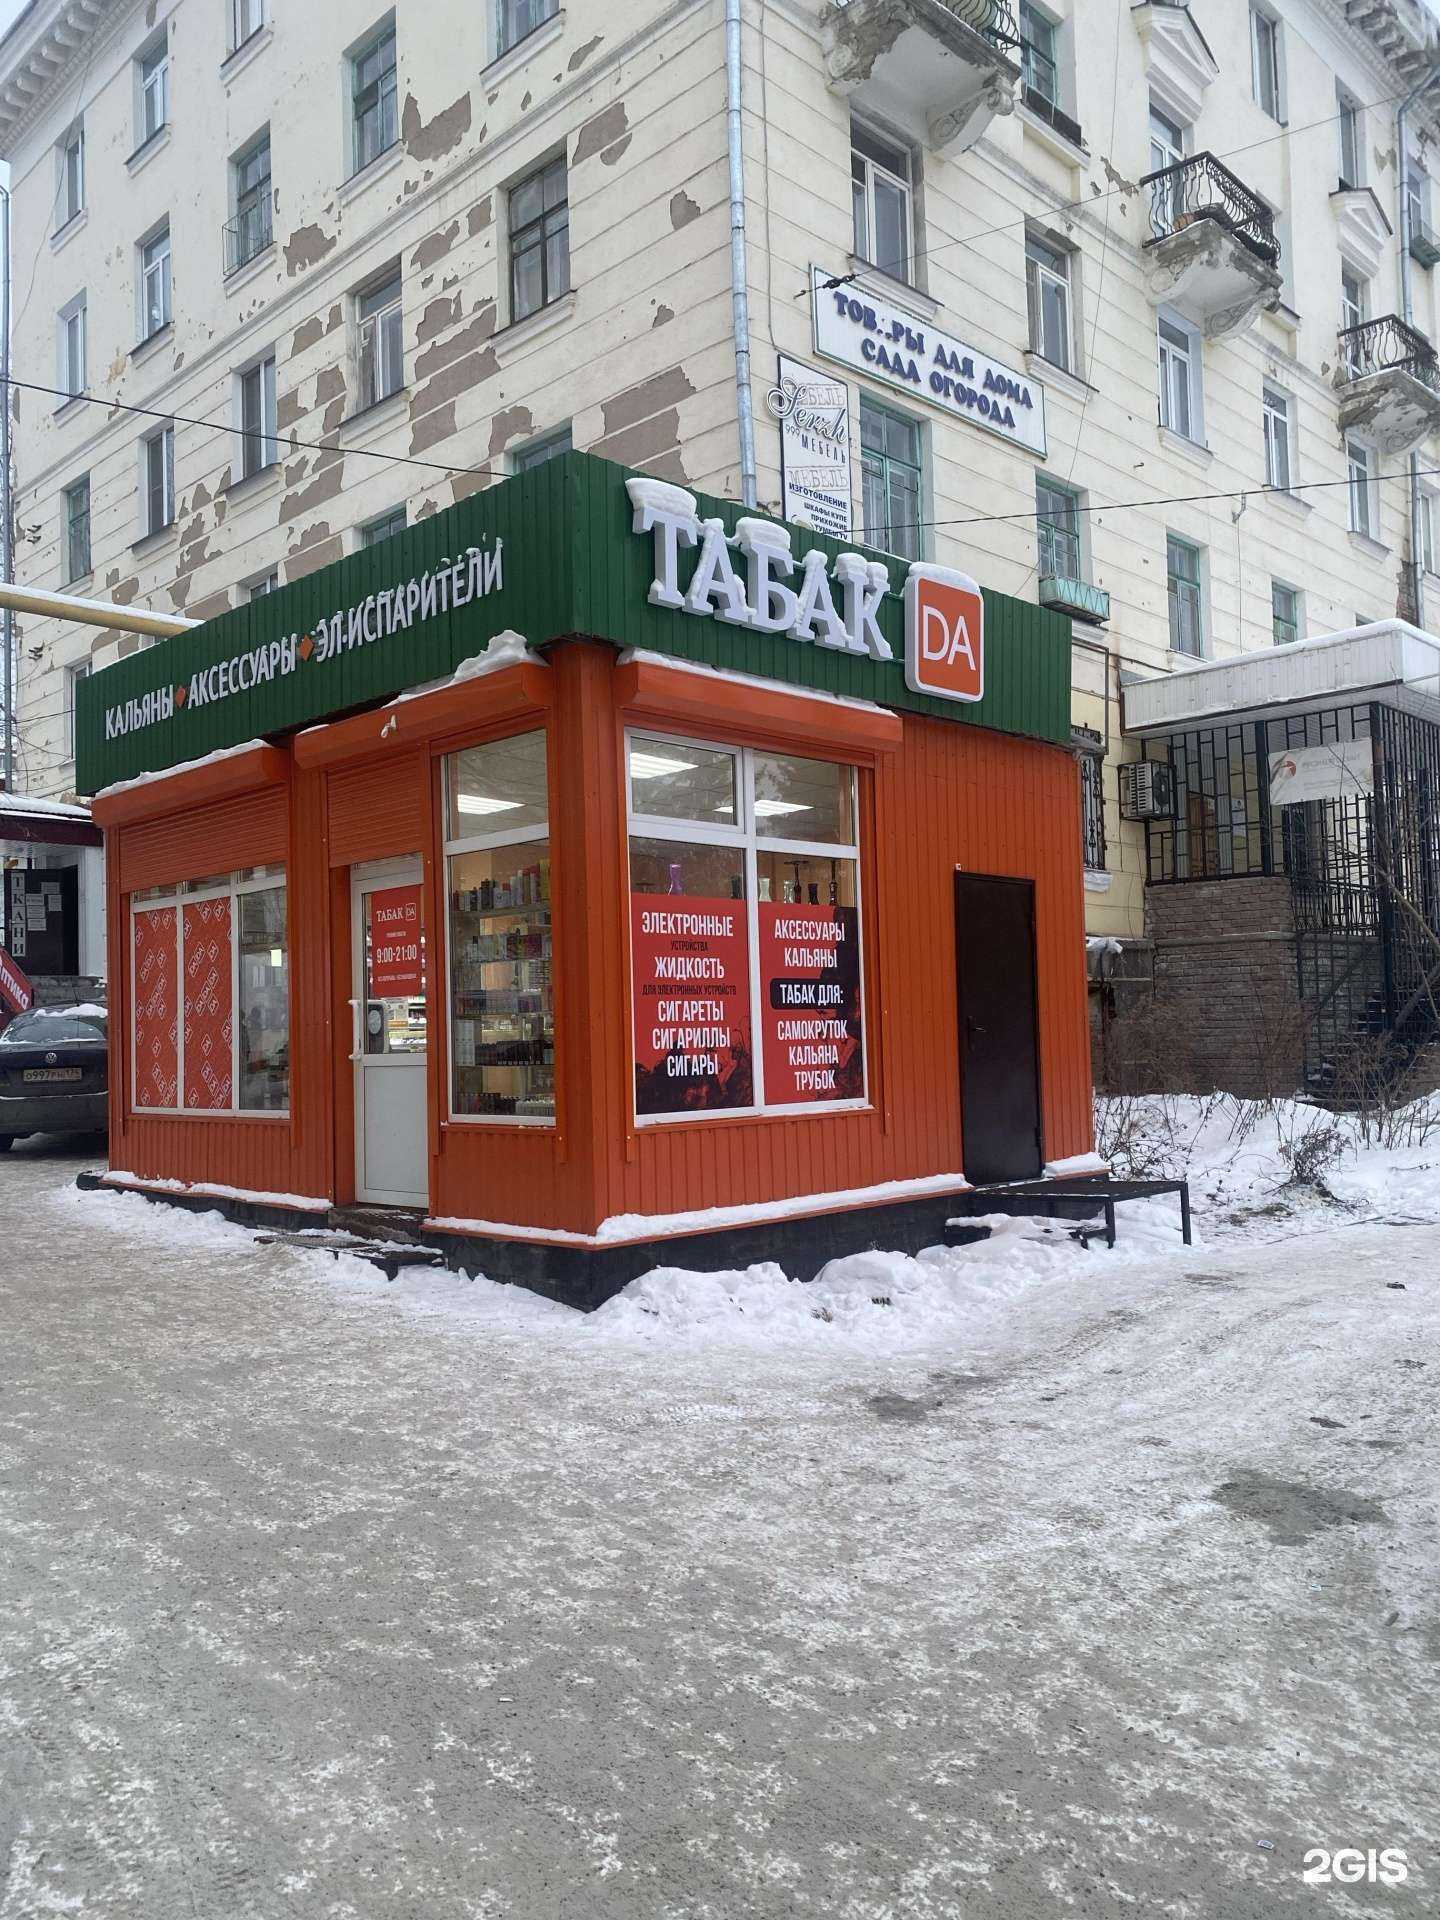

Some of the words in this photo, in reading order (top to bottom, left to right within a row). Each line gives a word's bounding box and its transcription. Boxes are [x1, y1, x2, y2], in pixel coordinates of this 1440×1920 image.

[833, 291, 926, 355] ТОВРЫ
[933, 343, 975, 379] ДЛЯ
[983, 368, 1034, 410] ДОМА
[861, 338, 922, 383] САДА
[929, 371, 1016, 429] ОГОРОДА
[801, 433, 846, 464] МЕБЕЛЬ
[788, 482, 848, 510] ИЗГОТОВЛЕНИЕ
[632, 505, 894, 662] ТАБАК
[923, 604, 977, 671] DA
[105, 685, 174, 740] КАЛЬЯНЫ
[188, 633, 298, 709] АКСЕССУАРЫ
[376, 907, 403, 922] ТАБАК
[642, 912, 734, 937] ЭЛЕКТРОННЫЕ
[775, 919, 846, 941] АКСЕССУАРЫ
[376, 944, 417, 964] 9:00-21:00
[671, 939, 708, 951] УСТРОЙСТВА
[654, 956, 725, 980] ЖИДКОСТЬ
[784, 947, 838, 968] КАЛЬЯНЫ
[642, 984, 657, 995] ДЛЯ
[658, 984, 702, 995] ЭЛЕКТРОННЫХ
[704, 983, 737, 996] УСТРОЙСТВ
[779, 984, 816, 1004] ТАБАК
[818, 984, 844, 1006] ДЛЯ:
[657, 1000, 724, 1022] СИГАРЕТЫ
[652, 1026, 730, 1050] СИГАРИЛЛЫ
[777, 1020, 848, 1041] САМОКРУТОК
[667, 1053, 718, 1077] СИГАРЫ
[788, 1045, 839, 1066] КАЛЬЯНА
[794, 1069, 836, 1091] ТРУБОК
